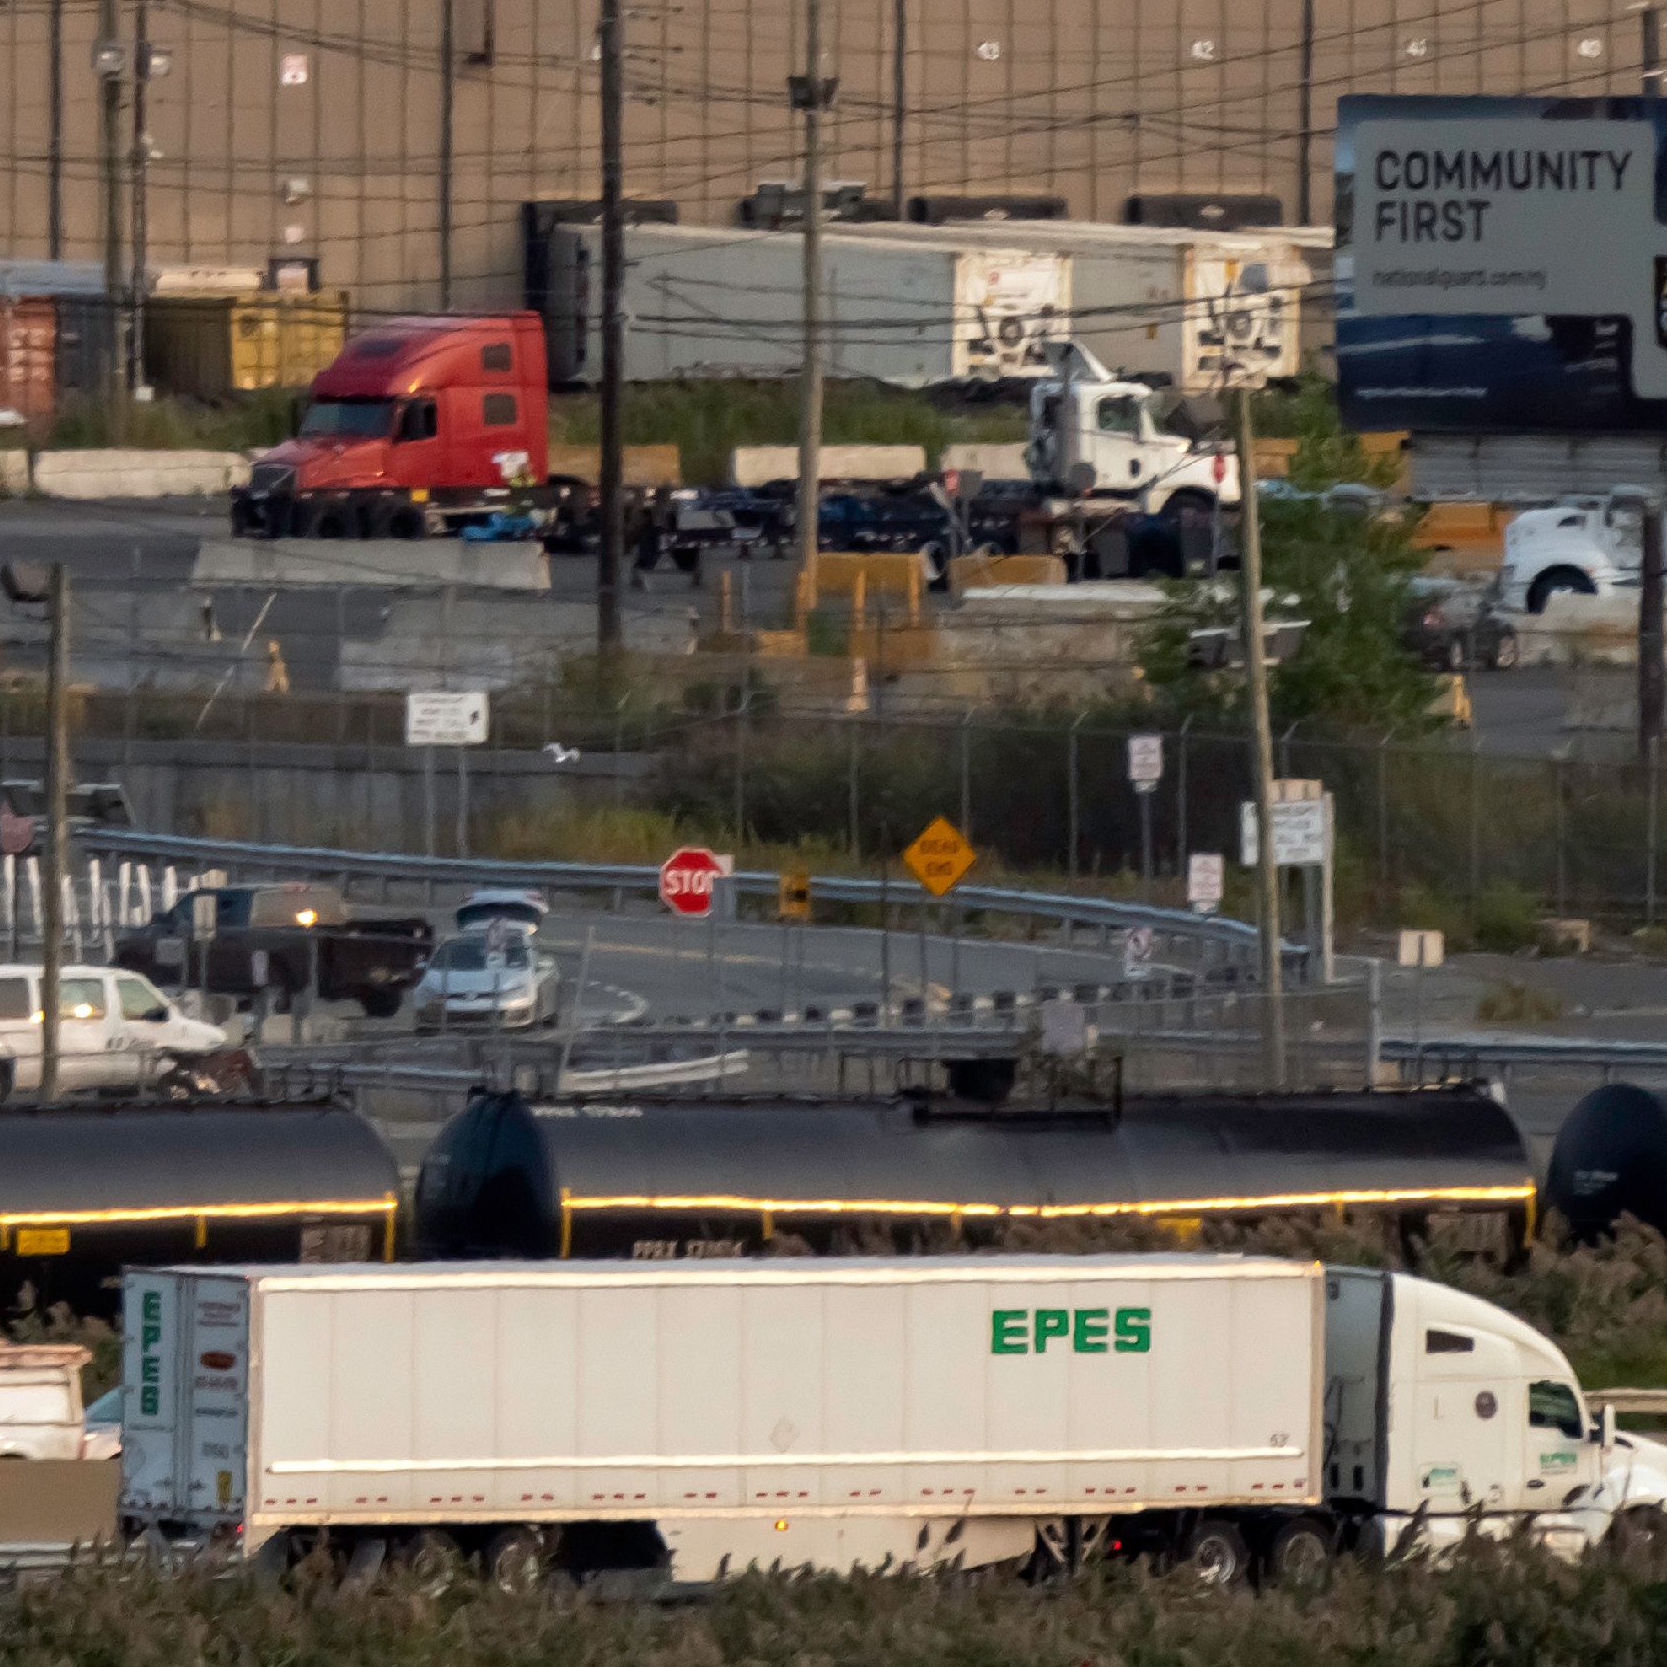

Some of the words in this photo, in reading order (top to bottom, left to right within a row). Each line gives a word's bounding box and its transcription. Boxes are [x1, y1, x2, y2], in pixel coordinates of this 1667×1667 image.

[1374, 149, 1633, 191] COMMUNITY
[1374, 199, 1492, 243] FIRST
[991, 1307, 1152, 1354] EPES
